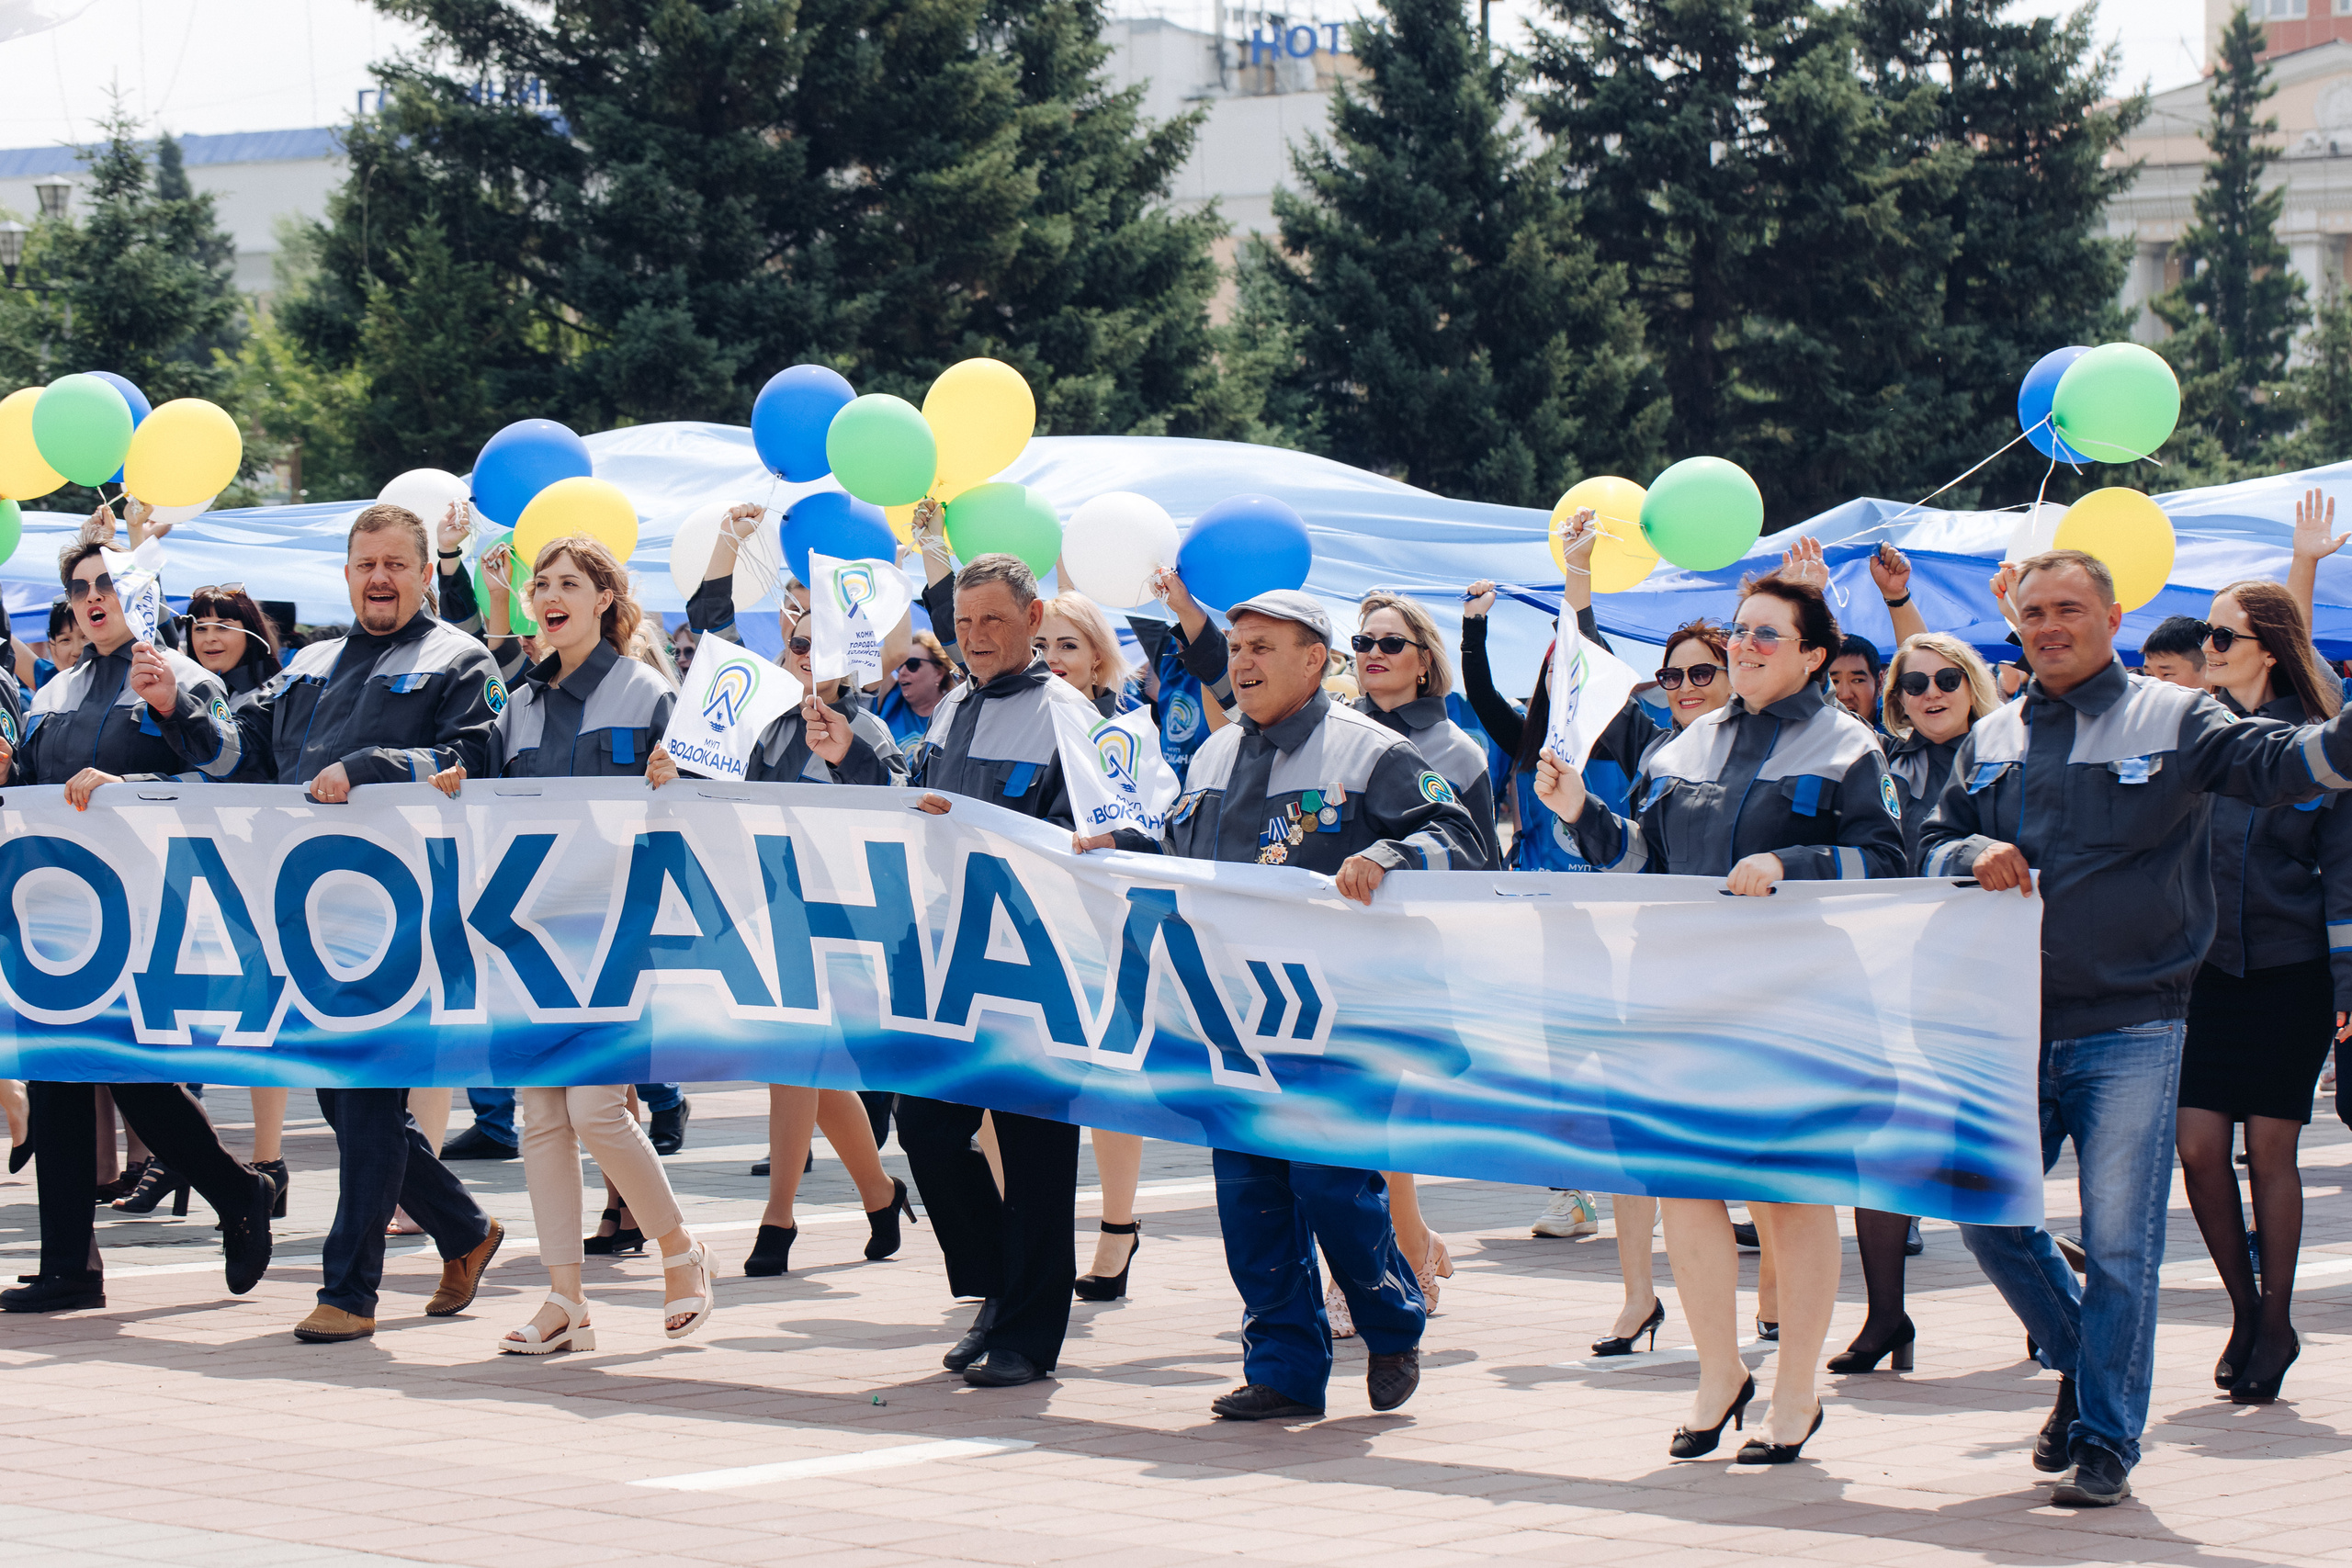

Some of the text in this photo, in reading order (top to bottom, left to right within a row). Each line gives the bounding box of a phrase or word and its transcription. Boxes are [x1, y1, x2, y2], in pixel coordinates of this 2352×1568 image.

[1251, 23, 1347, 64] HOT
[704, 738, 720, 750] МУП
[1116, 795, 1141, 810] МУП
[1567, 863, 1591, 872] МУП
